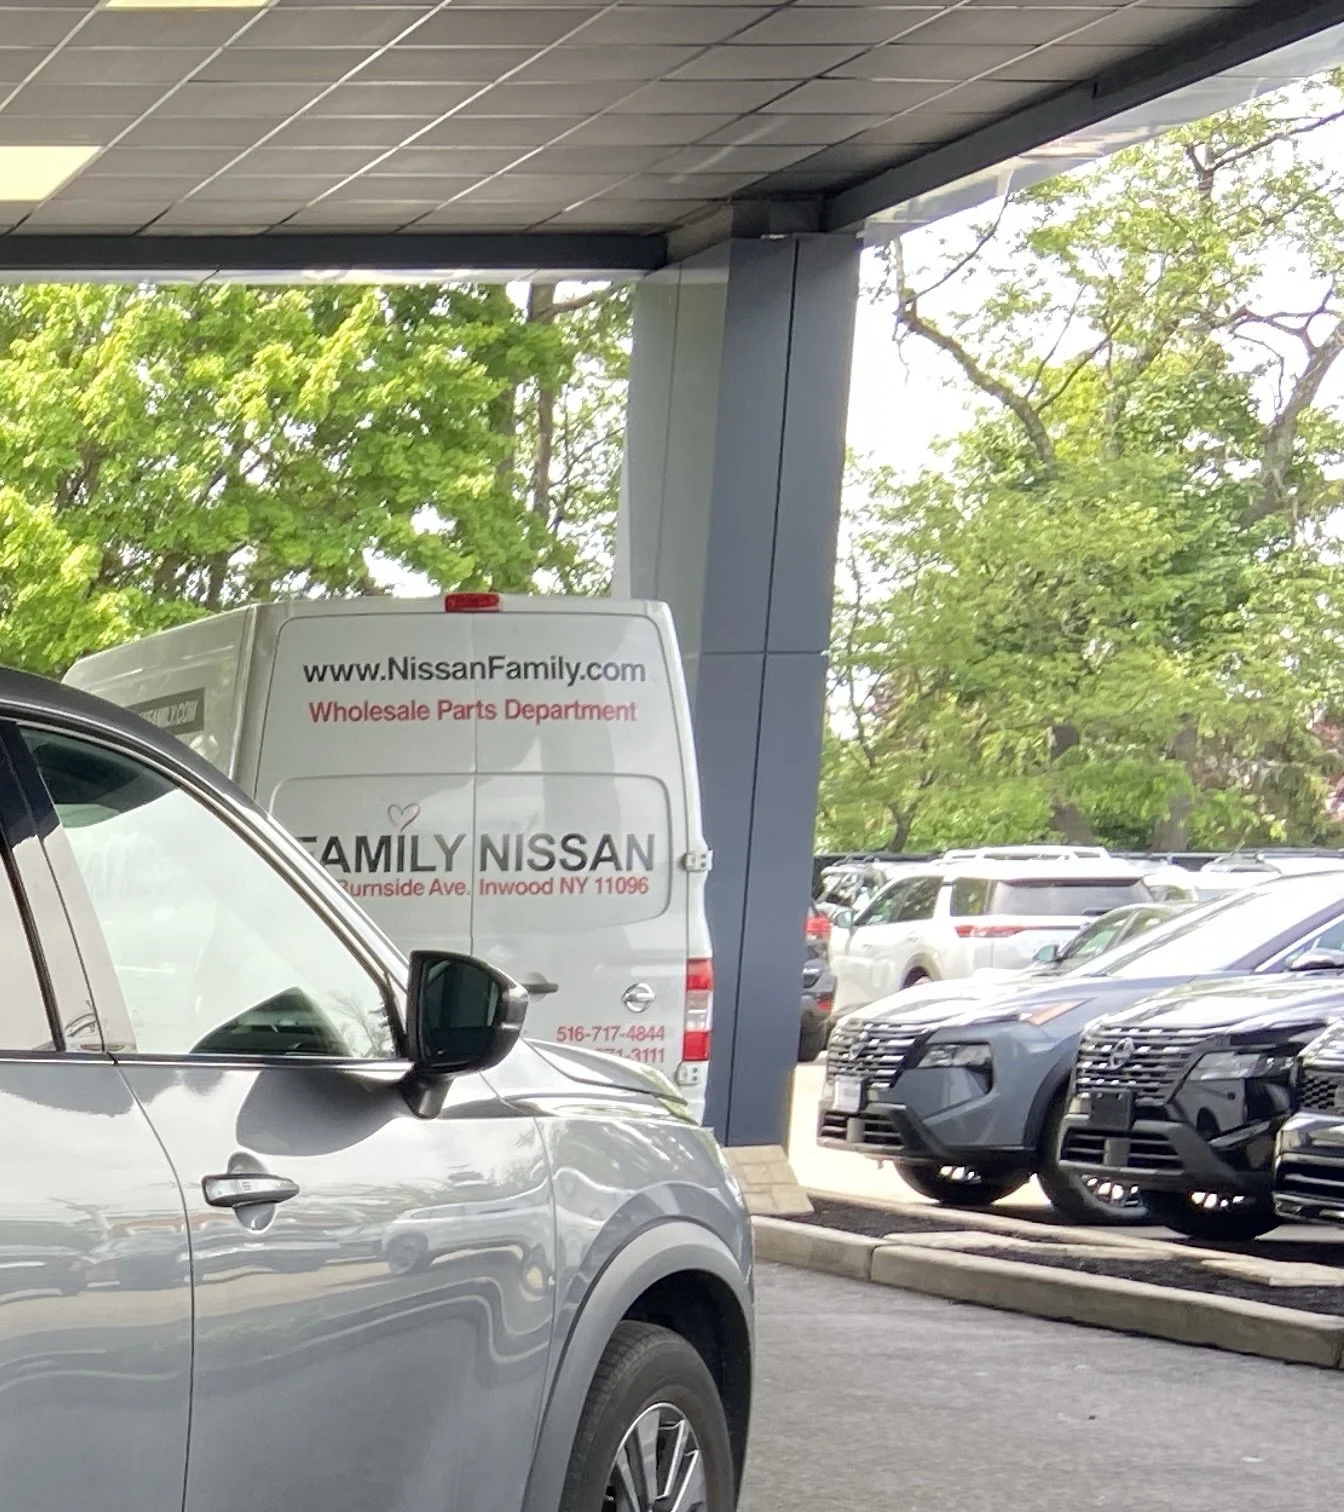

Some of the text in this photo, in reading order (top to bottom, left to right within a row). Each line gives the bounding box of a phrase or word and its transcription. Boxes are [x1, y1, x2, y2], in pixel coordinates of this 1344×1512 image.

[302, 654, 647, 688] www.NissanFamily.com
[309, 699, 637, 725] Wholesale Parts Department
[479, 832, 655, 873] NISSAN
[428, 878, 471, 896] Ave.
[478, 877, 554, 896] Inwood
[559, 877, 589, 895] NY
[594, 876, 649, 895] 11096
[556, 1025, 665, 1042] 516-717-4844
